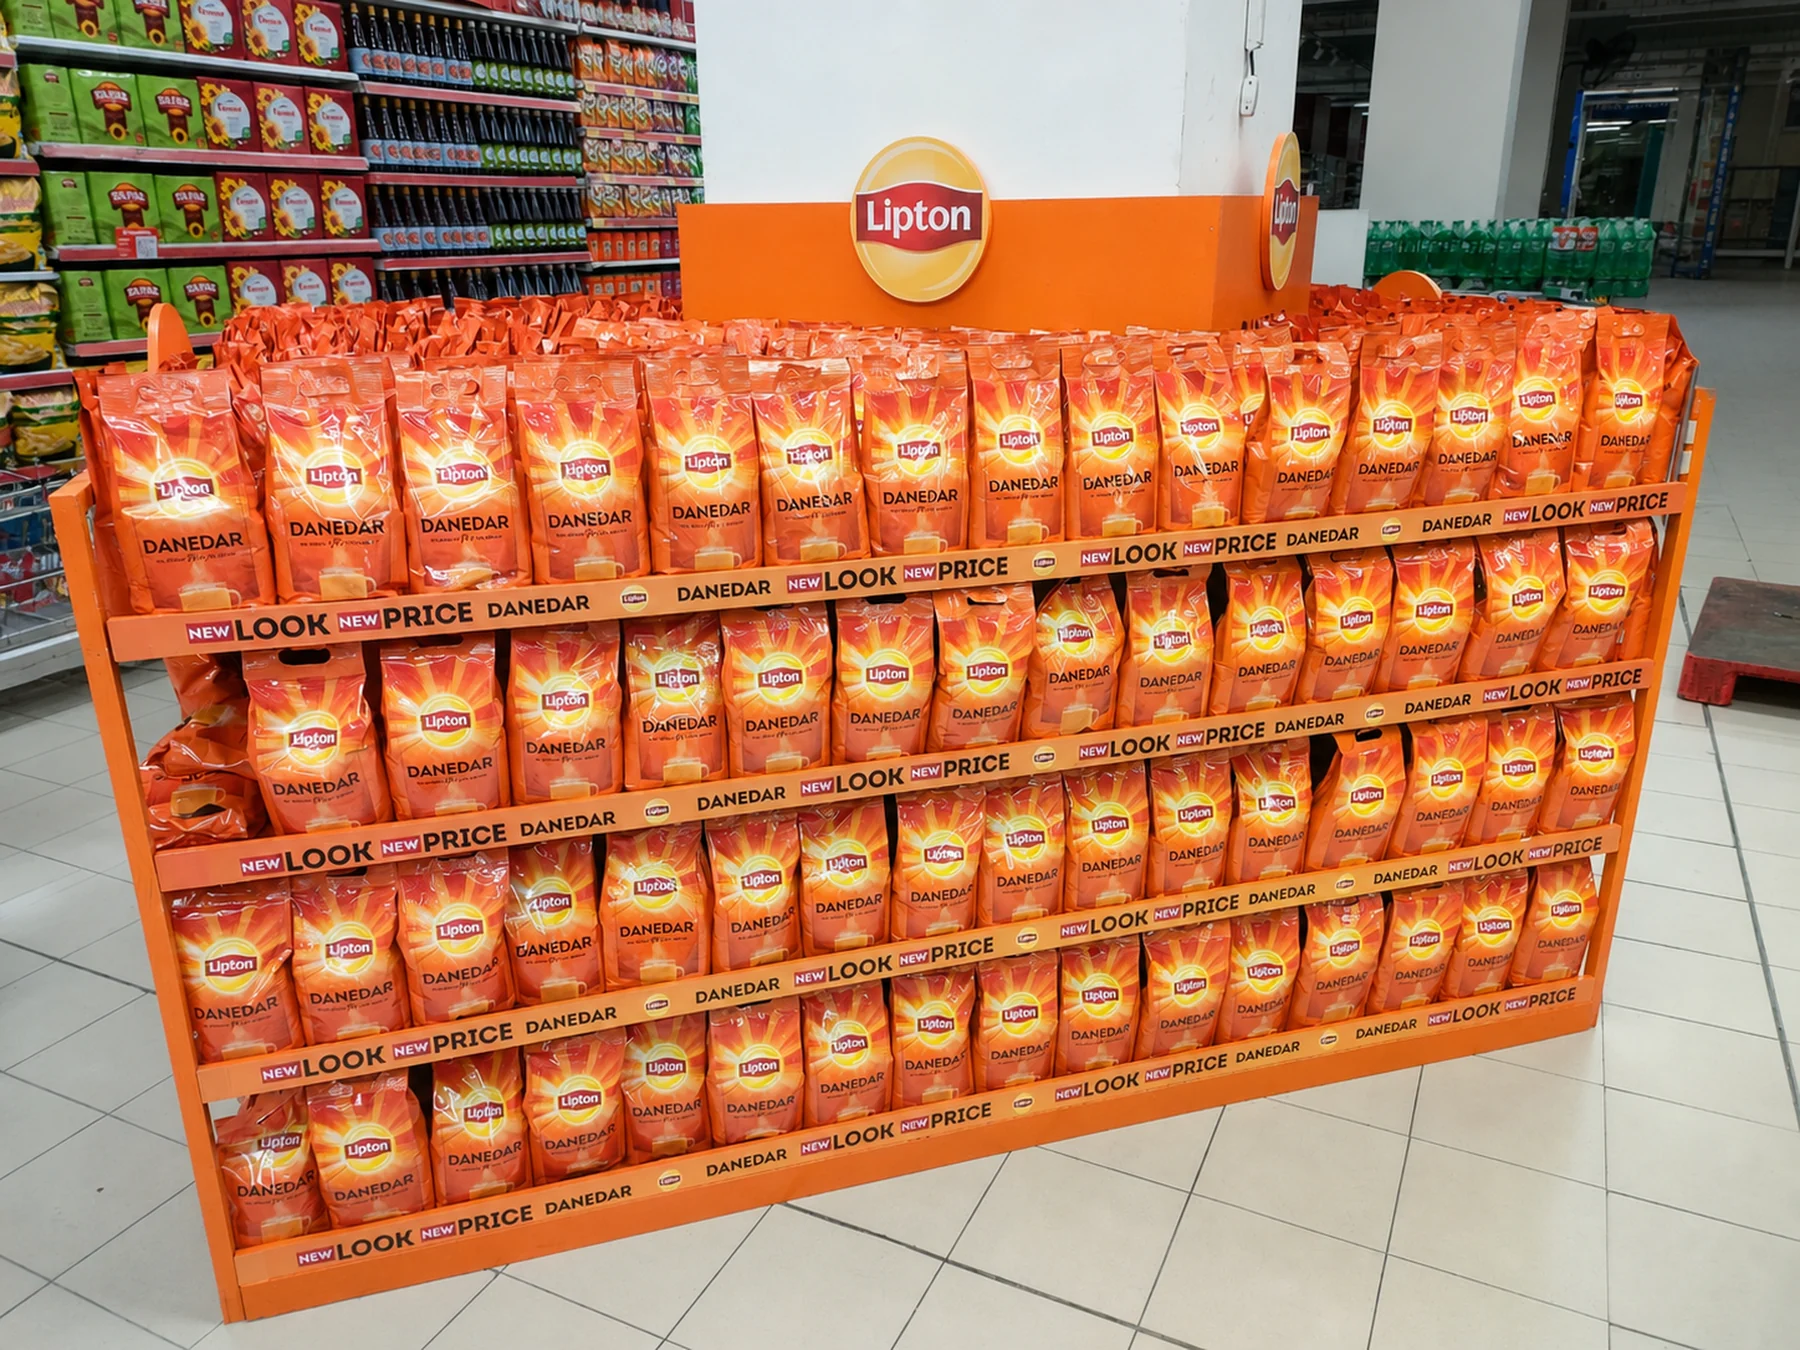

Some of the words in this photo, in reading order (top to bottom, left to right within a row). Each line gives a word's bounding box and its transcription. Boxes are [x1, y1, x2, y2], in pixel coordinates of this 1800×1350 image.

[1274, 194, 1297, 224] Lipton
[866, 198, 971, 239] Lipton
[1094, 429, 1129, 443] Lipton
[1293, 425, 1327, 440] Lipton
[687, 455, 727, 471] Lipton
[1439, 452, 1496, 464] DANEDAR
[441, 466, 487, 486] Lipton
[1359, 462, 1419, 474] DANEDAR
[990, 477, 1057, 492] DANEDAR
[1084, 471, 1151, 489] DANEDAR
[884, 490, 957, 504] DANEDAR
[673, 502, 749, 519] DANEDAR
[1423, 514, 1491, 532] DANEDAR
[1505, 511, 1528, 521] NEW
[1532, 501, 1585, 522] LOOK
[1591, 502, 1613, 511] NEW
[1616, 493, 1668, 512] PRICE
[290, 521, 383, 536] DANEDAR
[421, 516, 508, 532] DANEDAR
[144, 533, 243, 553] DANEDAR
[1083, 553, 1110, 563] NEW
[1115, 542, 1176, 565] LOOK
[1185, 543, 1211, 553] NEW
[1215, 533, 1276, 555] PRICE
[1287, 527, 1358, 546] DANEDAR
[678, 581, 770, 601] DANEDAR
[789, 578, 819, 589] NEW
[825, 567, 896, 591] LOOK
[905, 567, 934, 578] NEW
[939, 557, 1007, 580] PRICE
[1590, 585, 1622, 598] Lipton
[189, 626, 229, 639] NEW
[235, 614, 330, 640] LOOK
[340, 614, 377, 628] NEW
[384, 602, 473, 628] PRICE
[488, 596, 589, 617] DANEDAR
[1418, 604, 1450, 616] Lipton
[869, 668, 906, 682] Lipton
[969, 664, 1005, 678] Lipton
[1050, 666, 1109, 683] DANEDAR
[1239, 661, 1295, 677] DANEDAR
[658, 671, 697, 686] Lipton
[762, 670, 800, 685] Lipton
[1141, 672, 1201, 687] DANEDAR
[1405, 694, 1470, 714] DANEDAR
[1510, 679, 1561, 700] LOOK
[1592, 669, 1643, 690] PRICE
[546, 693, 586, 708] Lipton
[851, 709, 920, 723] DANEDAR
[953, 703, 1016, 718] DANEDAR
[425, 714, 467, 730] Lipton
[643, 715, 716, 732] DANEDAR
[747, 712, 817, 731] DANEDAR
[1081, 746, 1106, 756] NEW
[1111, 735, 1171, 758] LOOK
[1178, 734, 1202, 744] NEW
[1207, 722, 1265, 745] PRICE
[1276, 714, 1345, 734] DANEDAR
[527, 739, 604, 754] DANEDAR
[408, 758, 492, 777] DANEDAR
[273, 773, 359, 794] DANEDAR
[698, 787, 786, 811] DANEDAR
[803, 781, 831, 793] NEW
[837, 768, 904, 793] LOOK
[912, 766, 939, 777] NEW
[945, 753, 1009, 777] PRICE
[1180, 807, 1211, 820] Lipton
[242, 858, 279, 872] NEW
[286, 842, 373, 872] LOOK
[383, 840, 418, 853] NEW
[424, 824, 506, 853] PRICE
[521, 812, 616, 837] DANEDAR
[1083, 855, 1141, 871] DANEDAR
[1375, 865, 1438, 885] DANEDAR
[1450, 862, 1471, 870] NEW
[1475, 850, 1523, 870] LOOK
[1530, 849, 1550, 857] NEW
[1554, 837, 1601, 856] PRICE
[744, 872, 779, 887] Lipton
[997, 868, 1058, 887] DANEDAR
[817, 894, 882, 913] DANEDAR
[1062, 925, 1086, 935] NEW
[1091, 910, 1150, 935] LOOK
[1155, 908, 1178, 918] NEW
[1184, 895, 1238, 917] PRICE
[1250, 885, 1315, 904] DANEDAR
[440, 922, 479, 937] Lipton
[620, 922, 693, 937] DANEDAR
[329, 941, 369, 957] Lipton
[210, 958, 252, 973] Lipton
[696, 978, 779, 1004] DANEDAR
[796, 971, 823, 984] NEW
[829, 956, 892, 983] LOOK
[901, 953, 927, 964] NEW
[932, 937, 993, 963] PRICE
[311, 982, 392, 1004] DANEDAR
[194, 997, 277, 1019] DANEDAR
[1004, 1007, 1036, 1021] Lipton
[1357, 1019, 1416, 1038] DANEDAR
[1453, 1002, 1500, 1022] LOOK
[1530, 988, 1575, 1006] PRICE
[921, 1017, 953, 1031] Lipton
[1071, 1024, 1129, 1040] DANEDAR
[263, 1066, 297, 1080] NEW
[303, 1046, 384, 1077] LOOK
[395, 1042, 428, 1056] NEW
[434, 1023, 513, 1053] PRICE
[527, 1007, 616, 1034] DANEDAR
[649, 1060, 683, 1074] Lipton
[743, 1059, 777, 1074] Lipton
[1057, 1088, 1080, 1099] NEW
[1085, 1072, 1138, 1096] LOOK
[1147, 1069, 1169, 1079] NEW
[1173, 1054, 1227, 1077] PRICE
[1237, 1042, 1299, 1062] DANEDAR
[820, 1072, 884, 1095] DANEDAR
[562, 1094, 598, 1108] Lipton
[633, 1099, 701, 1116] DANEDAR
[728, 1096, 793, 1112] DANEDAR
[261, 1134, 299, 1150] Lipton
[545, 1123, 615, 1150] DANEDAR
[707, 1149, 786, 1176] DANEDAR
[803, 1140, 829, 1152] NEW
[834, 1123, 893, 1149] LOOK
[903, 1119, 927, 1130] NEW
[932, 1103, 990, 1128] PRICE
[348, 1141, 388, 1156] Lipton
[449, 1142, 521, 1165] DANEDAR
[238, 1169, 318, 1196] DANEDAR
[335, 1174, 412, 1200] DANEDAR
[300, 1250, 331, 1263] NEW
[337, 1231, 413, 1260] LOOK
[423, 1225, 453, 1238] NEW
[459, 1205, 532, 1234] PRICE
[546, 1186, 631, 1214] DANEDAR
